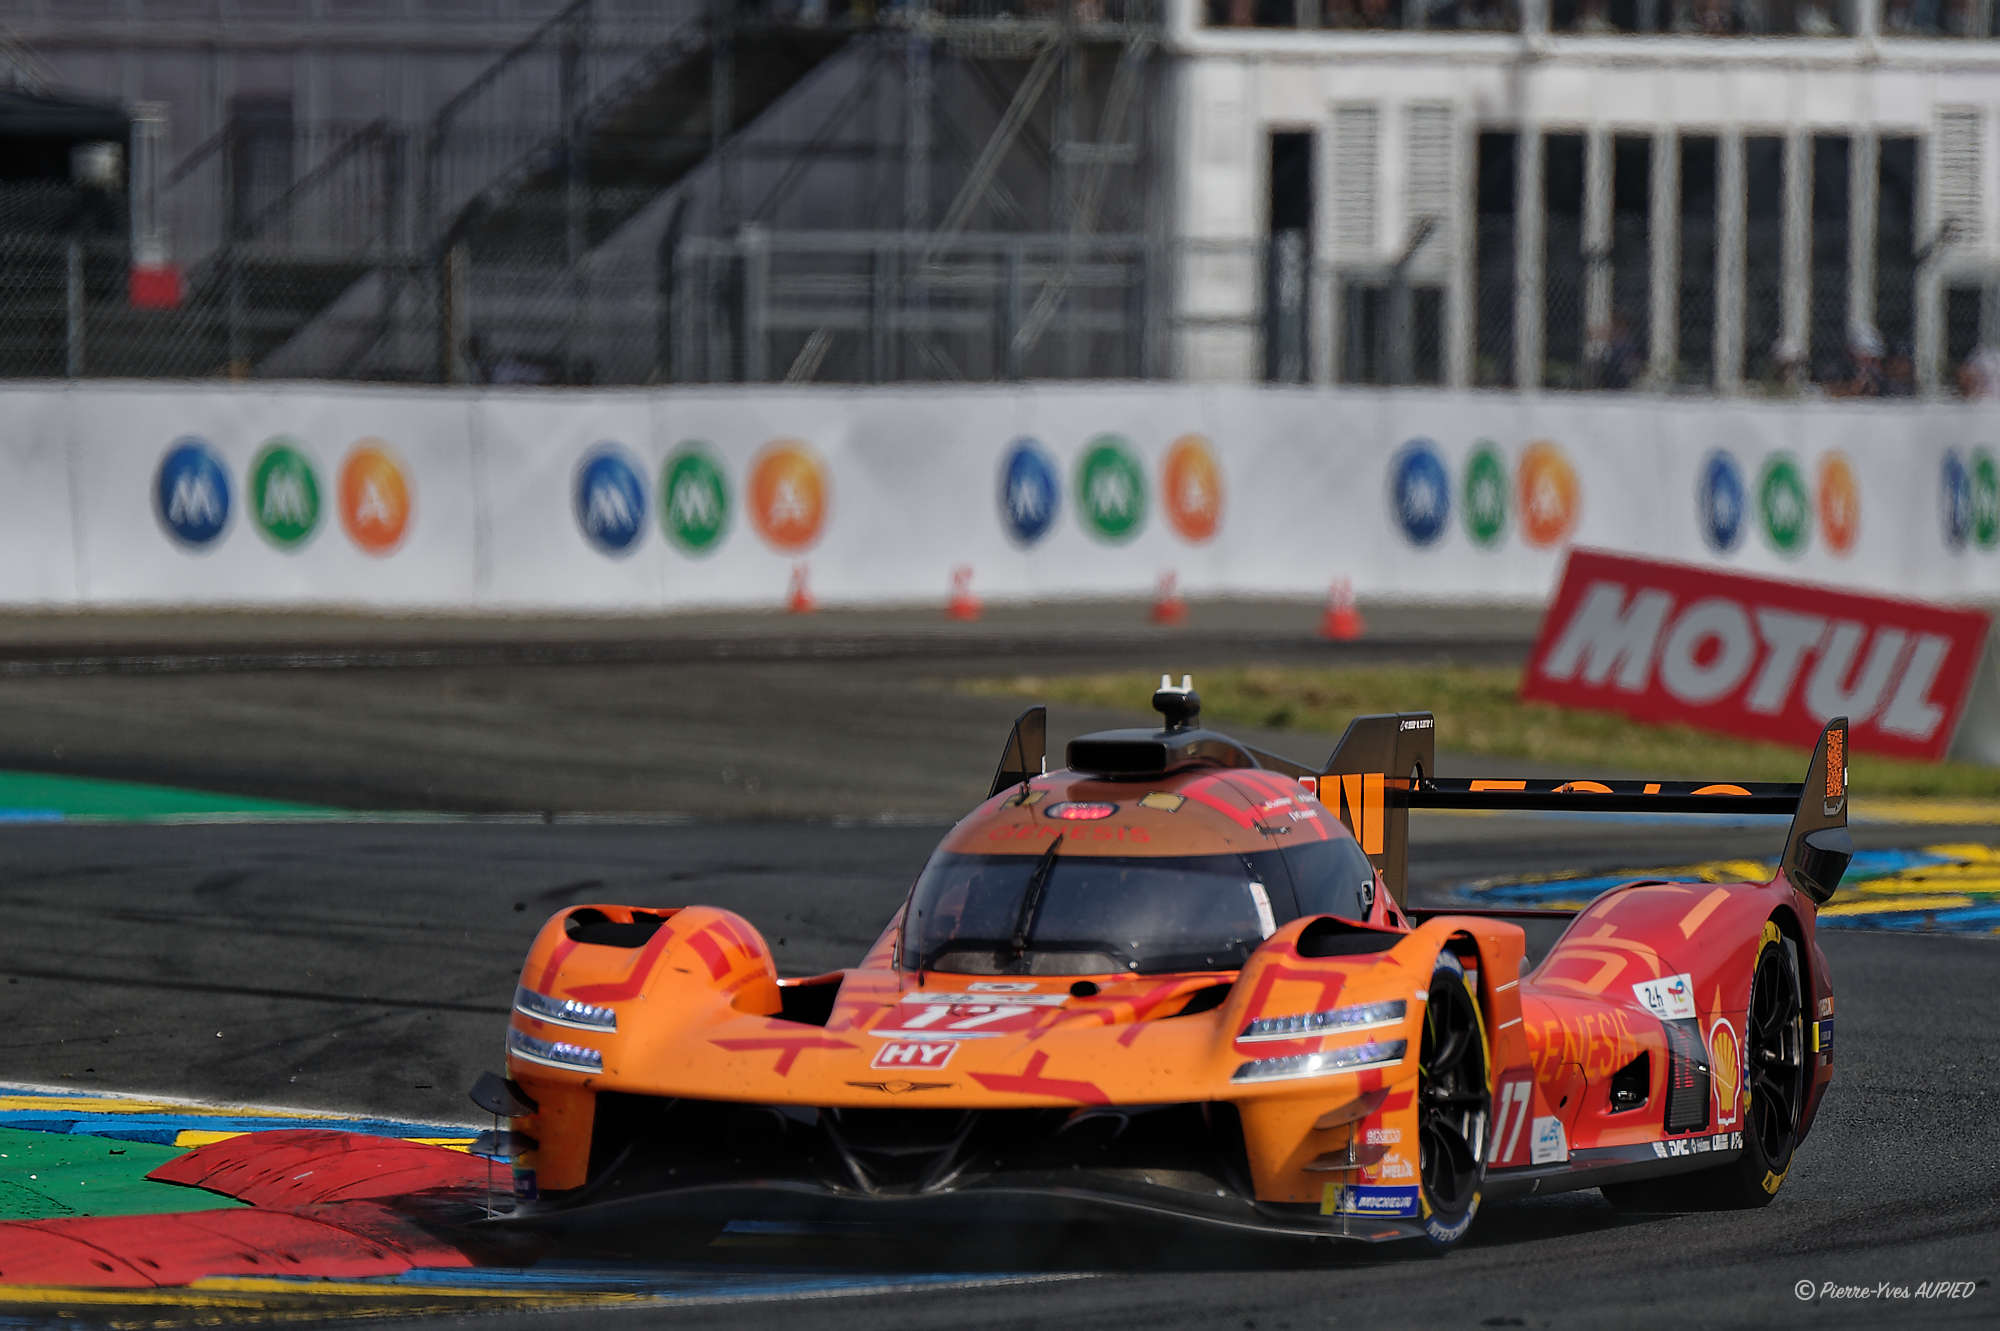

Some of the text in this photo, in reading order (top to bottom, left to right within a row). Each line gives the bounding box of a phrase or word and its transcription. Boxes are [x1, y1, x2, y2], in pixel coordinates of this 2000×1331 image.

[1540, 579, 1953, 743] MOTUL
[988, 825, 1150, 843] GENESIS
[901, 1003, 1036, 1030] 17
[880, 1044, 950, 1064] HY
[1488, 1081, 1532, 1162] 17
